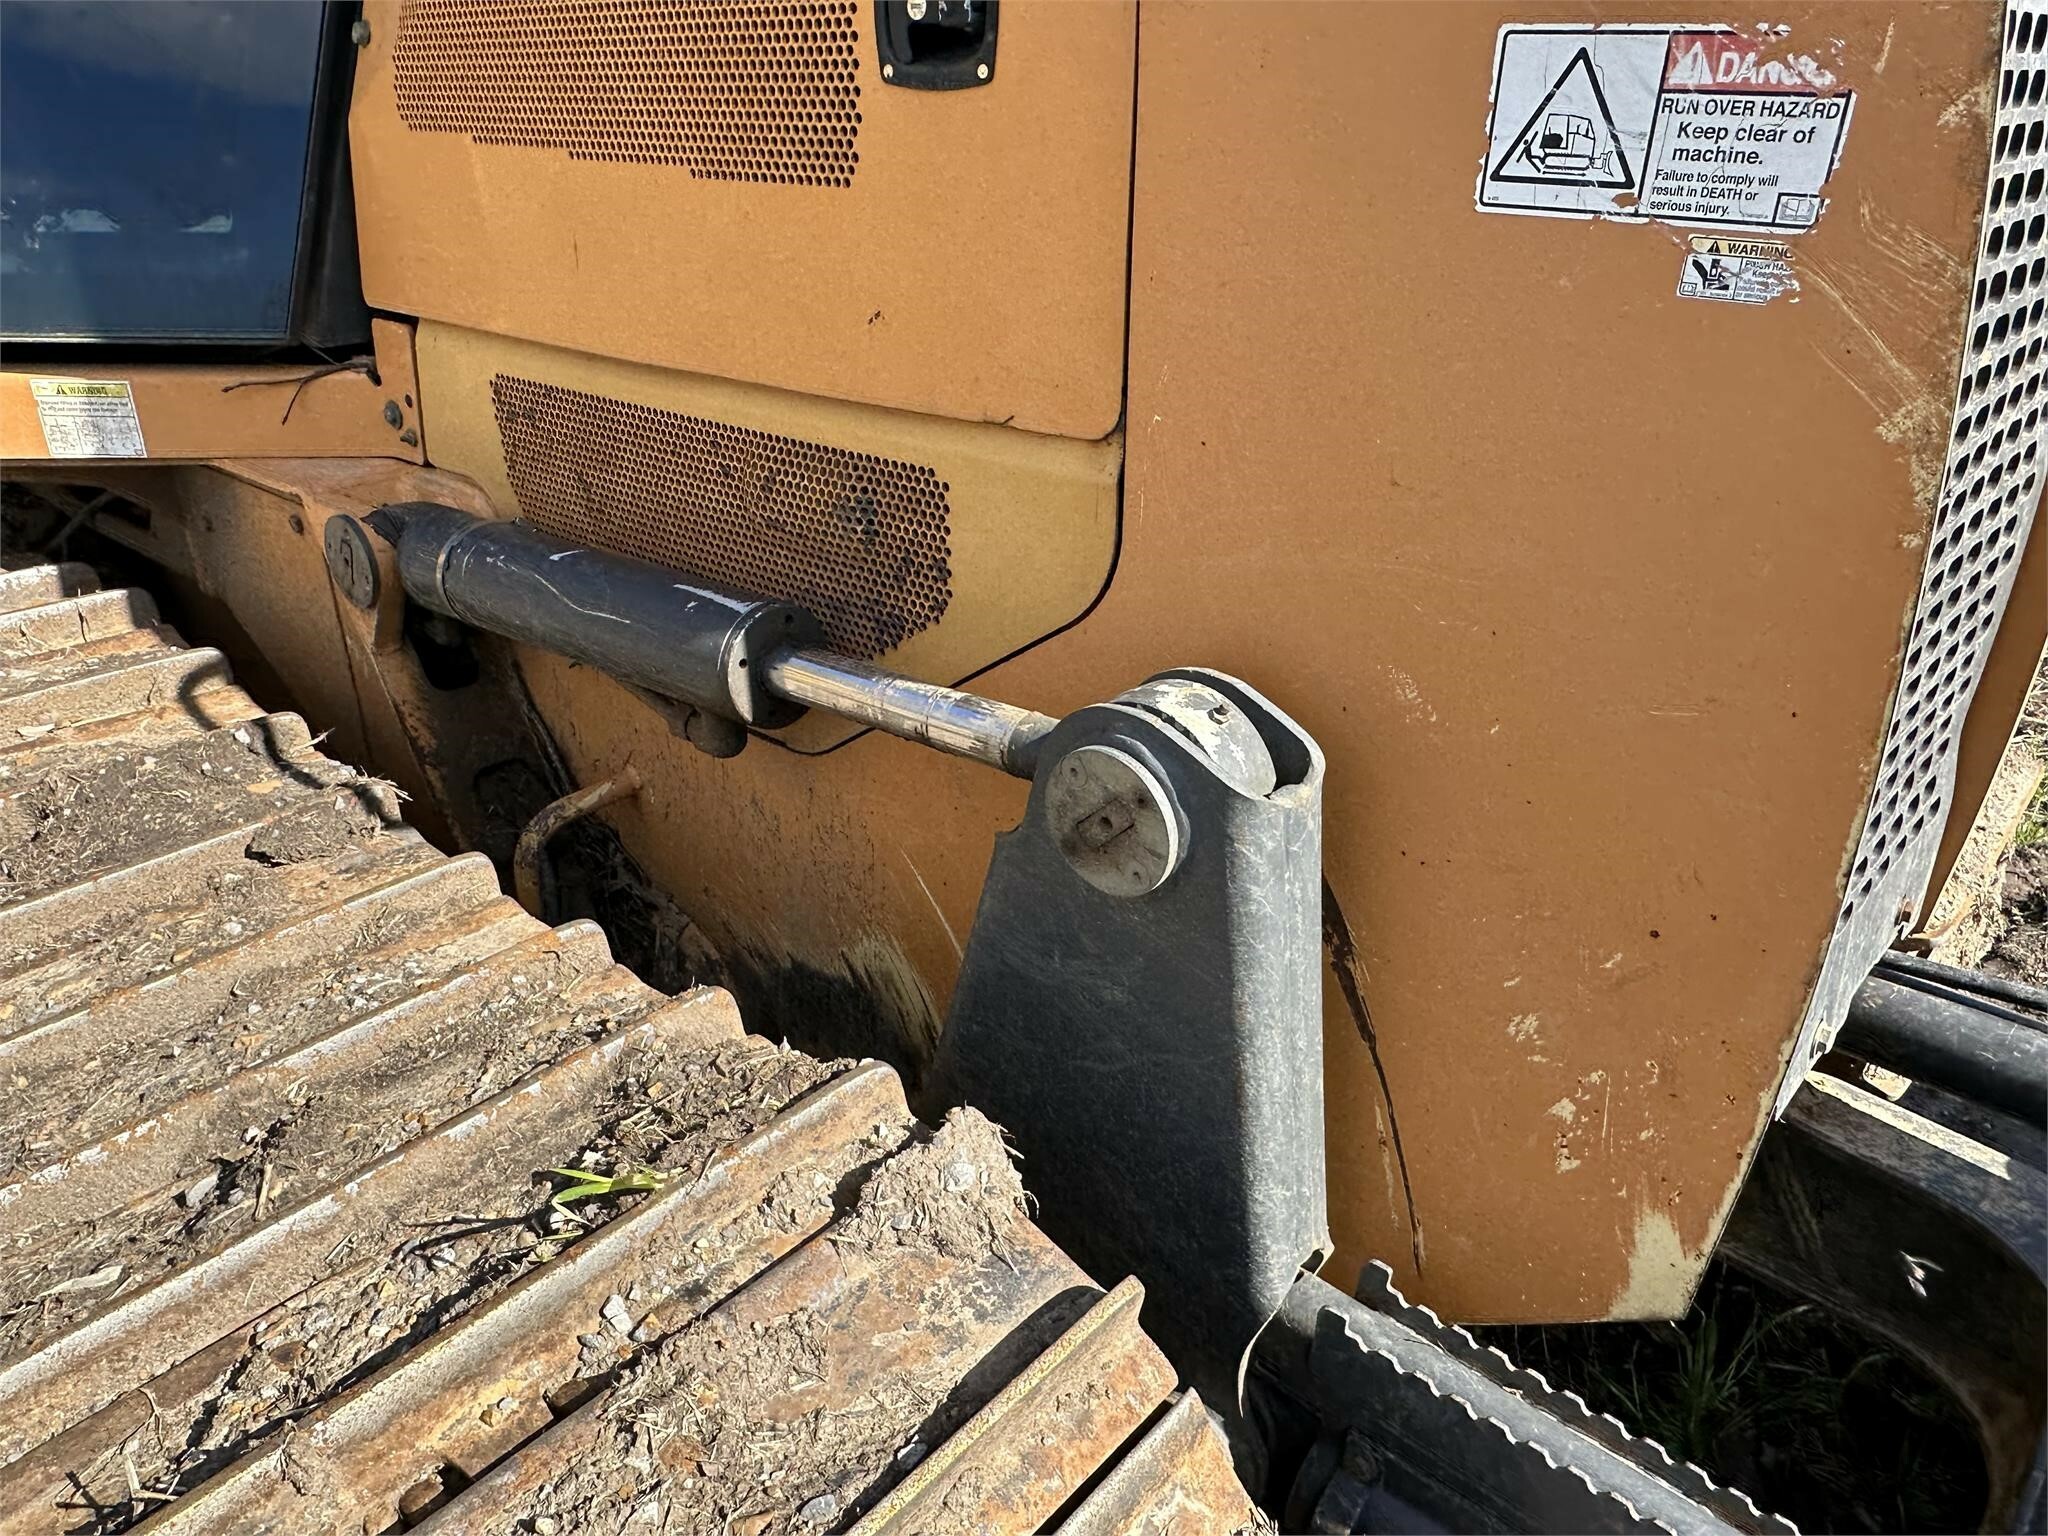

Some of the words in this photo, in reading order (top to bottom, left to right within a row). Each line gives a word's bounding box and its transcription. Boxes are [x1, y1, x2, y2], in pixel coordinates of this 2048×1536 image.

[1715, 51, 1836, 87] DAN
[1661, 97, 1699, 115] RUN
[1704, 99, 1755, 117] OVER
[1759, 101, 1841, 119] HAZARD
[1677, 121, 1728, 144] Keep
[1735, 124, 1788, 142] clear
[1793, 126, 1816, 143] of
[1672, 146, 1764, 164] machine.
[1654, 169, 1694, 182] Failure
[1696, 171, 1709, 183] to
[1711, 174, 1757, 188] comply
[1758, 175, 1779, 187] will
[1652, 185, 1684, 197] result
[1686, 186, 1697, 198] in
[1700, 187, 1743, 200] DEATH
[1744, 191, 1759, 201] or
[1650, 200, 1692, 212] serious
[1694, 202, 1730, 217] injury.
